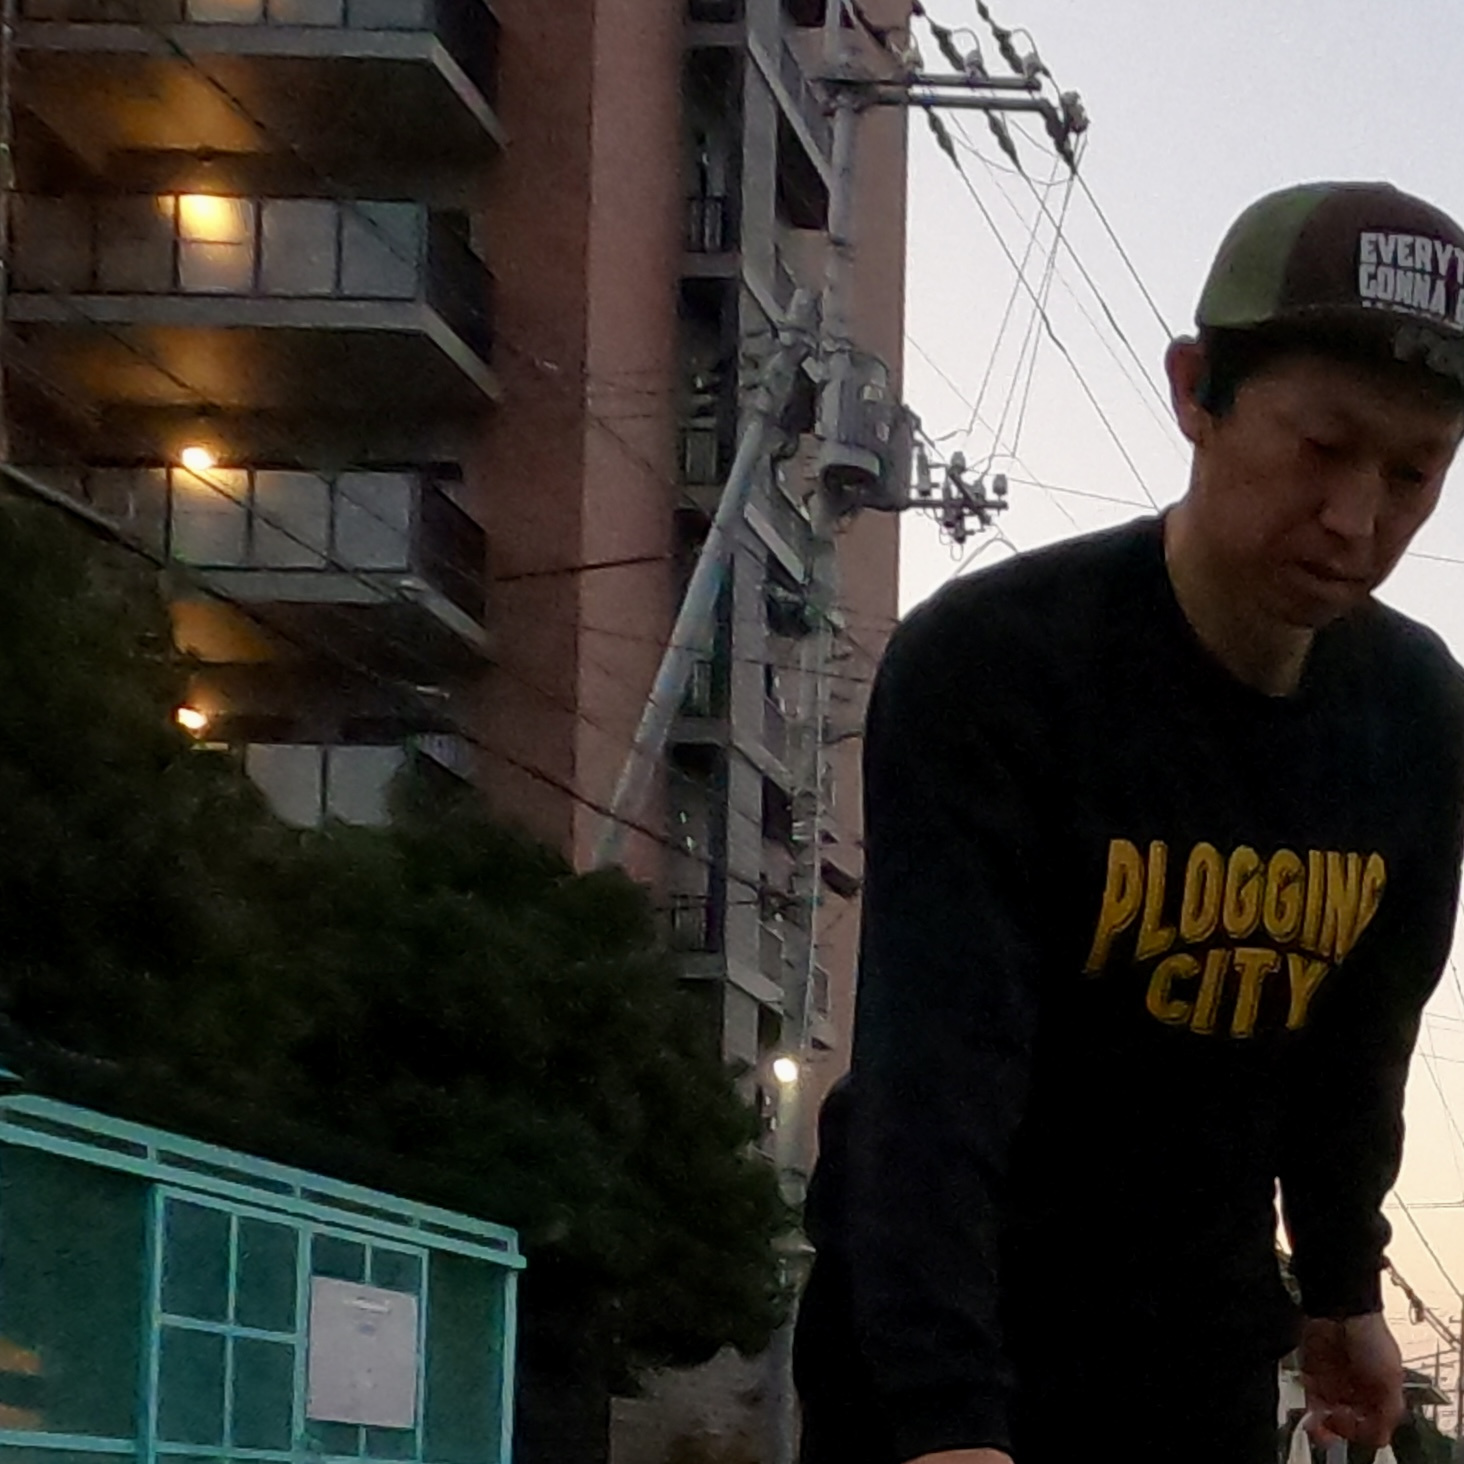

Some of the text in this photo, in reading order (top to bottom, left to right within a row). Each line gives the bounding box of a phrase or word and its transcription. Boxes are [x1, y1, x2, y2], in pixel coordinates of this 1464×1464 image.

[1359, 263, 1447, 316] GONNA
[1082, 838, 1388, 978] PLOGGING
[1145, 947, 1332, 1039] CITY
